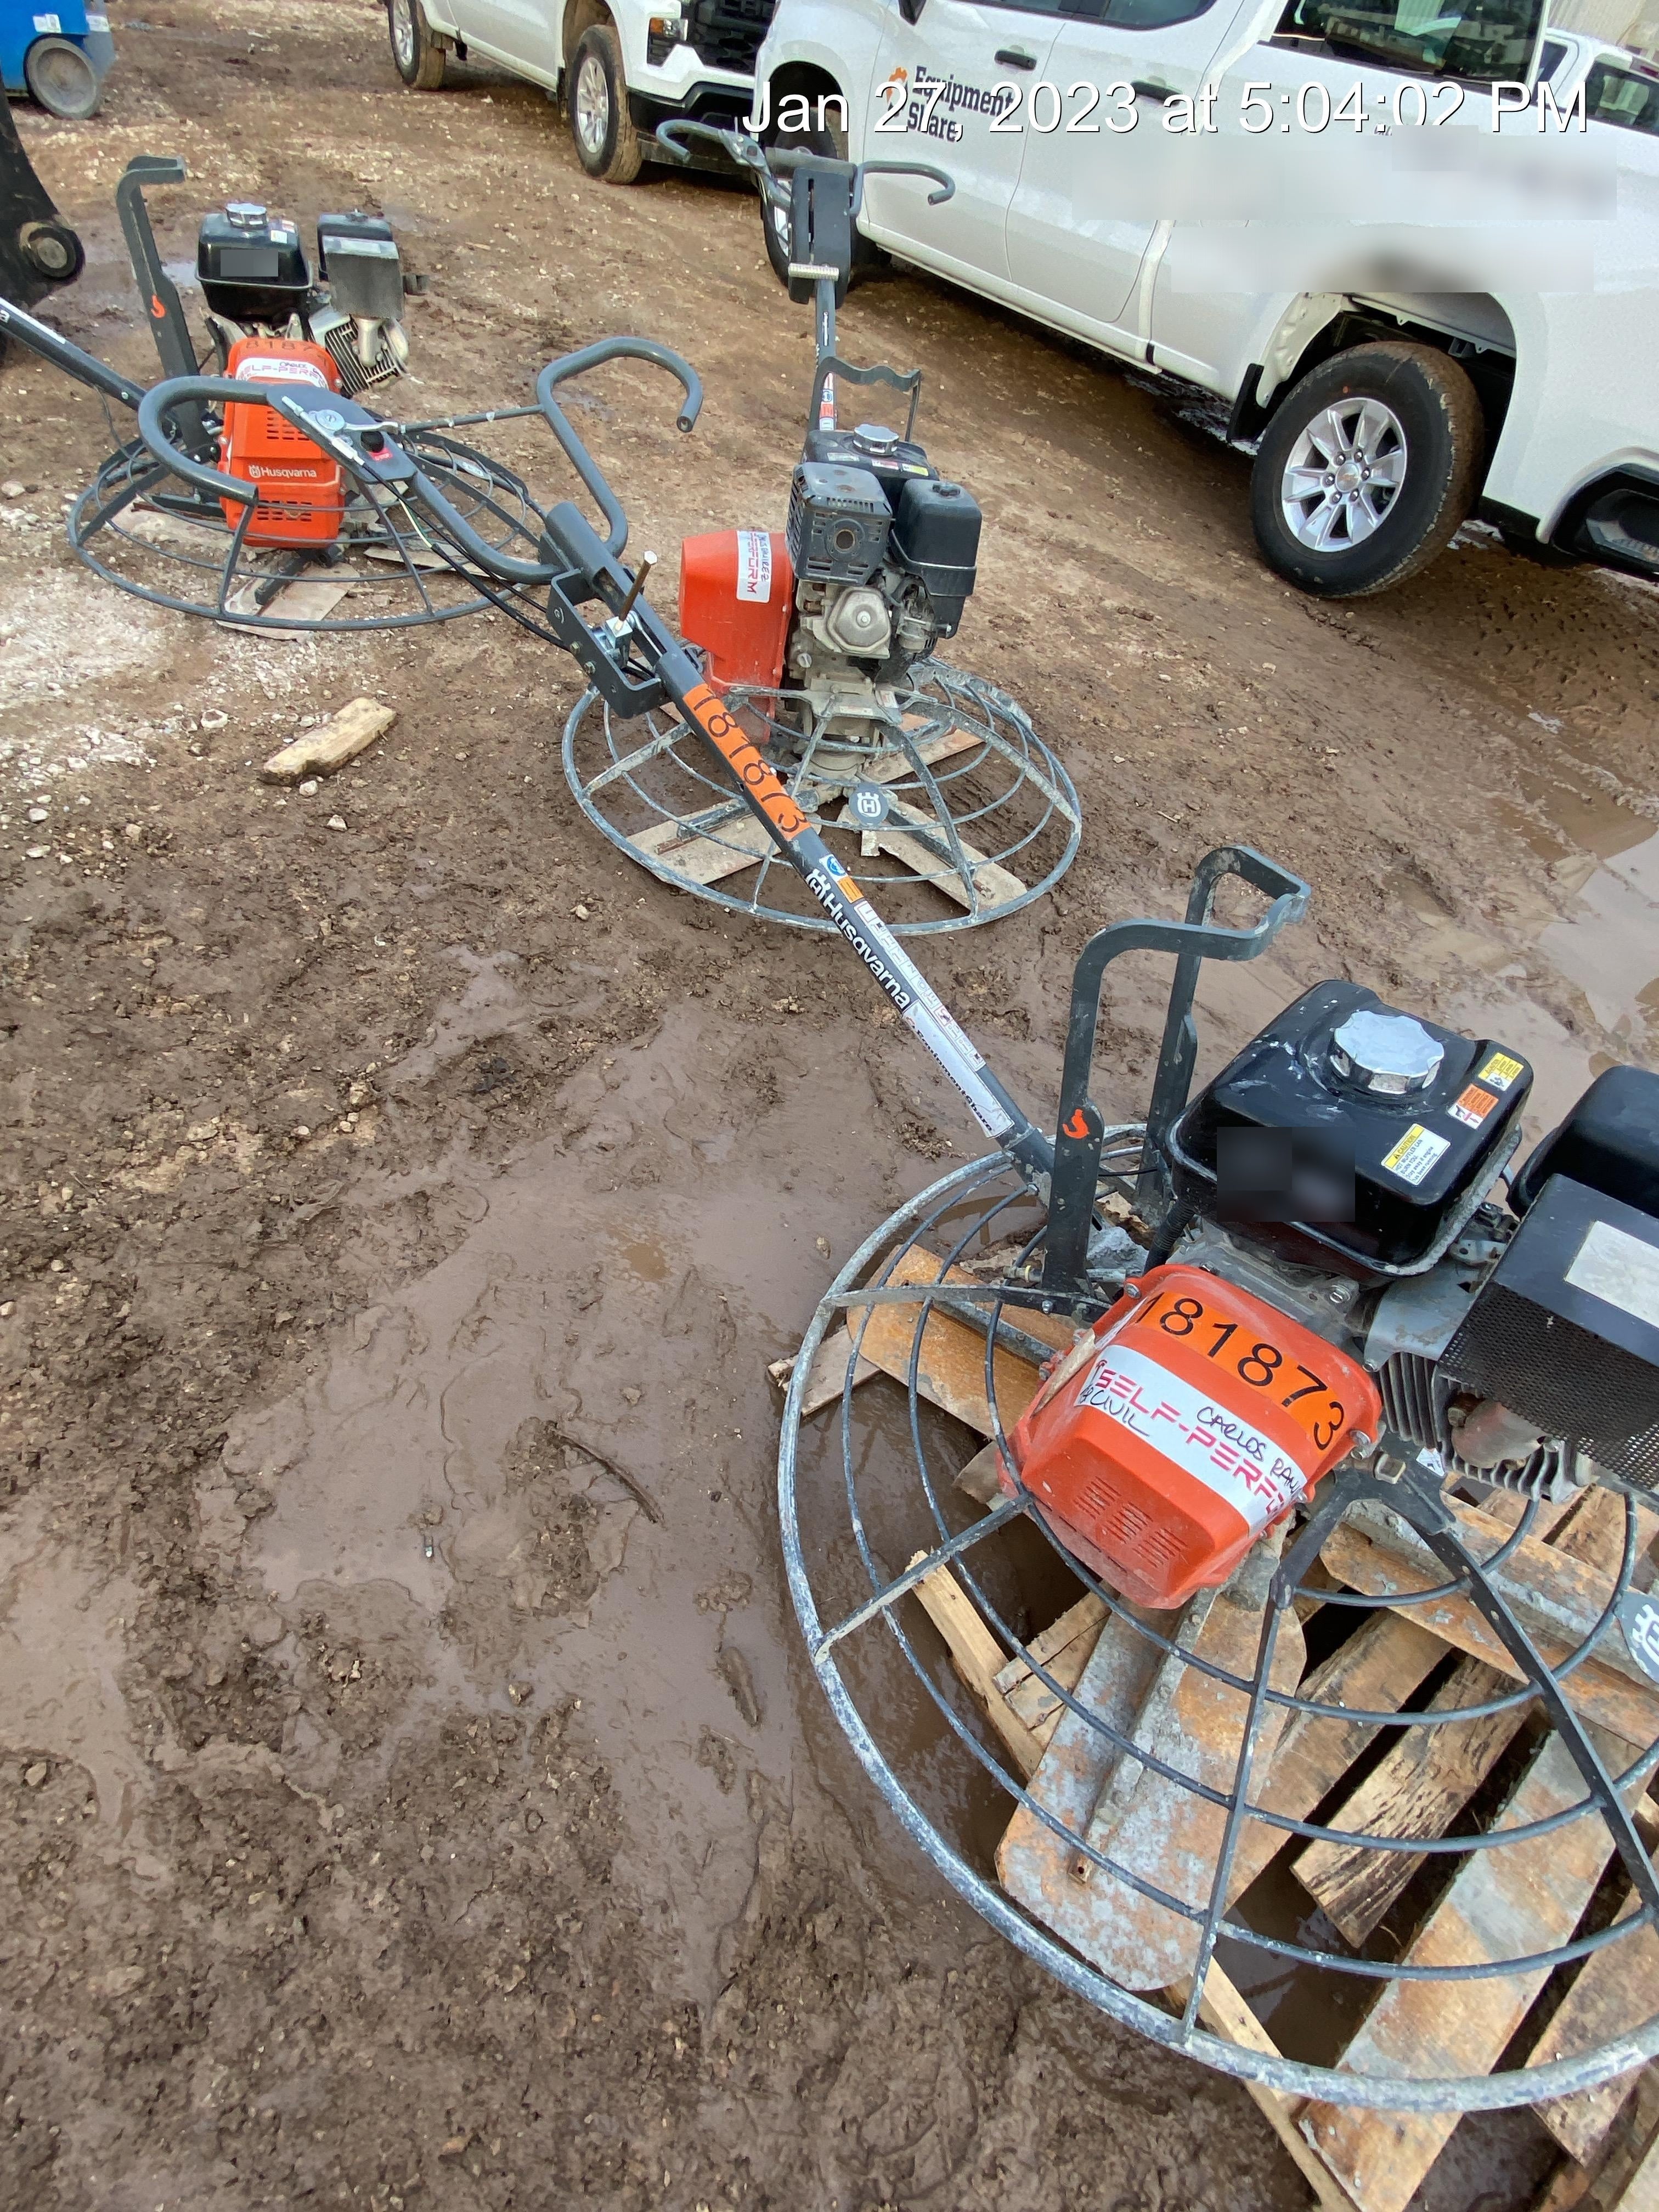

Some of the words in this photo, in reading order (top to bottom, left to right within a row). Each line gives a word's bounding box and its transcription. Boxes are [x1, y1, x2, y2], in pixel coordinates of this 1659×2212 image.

[262, 467, 317, 478] Husqvarna
[823, 894, 911, 1009] Husqvarna
[1397, 1134, 1415, 1154] CAUTION
[1135, 1292, 1345, 1450] 181873
[1197, 1406, 1267, 1462] CARLOS
